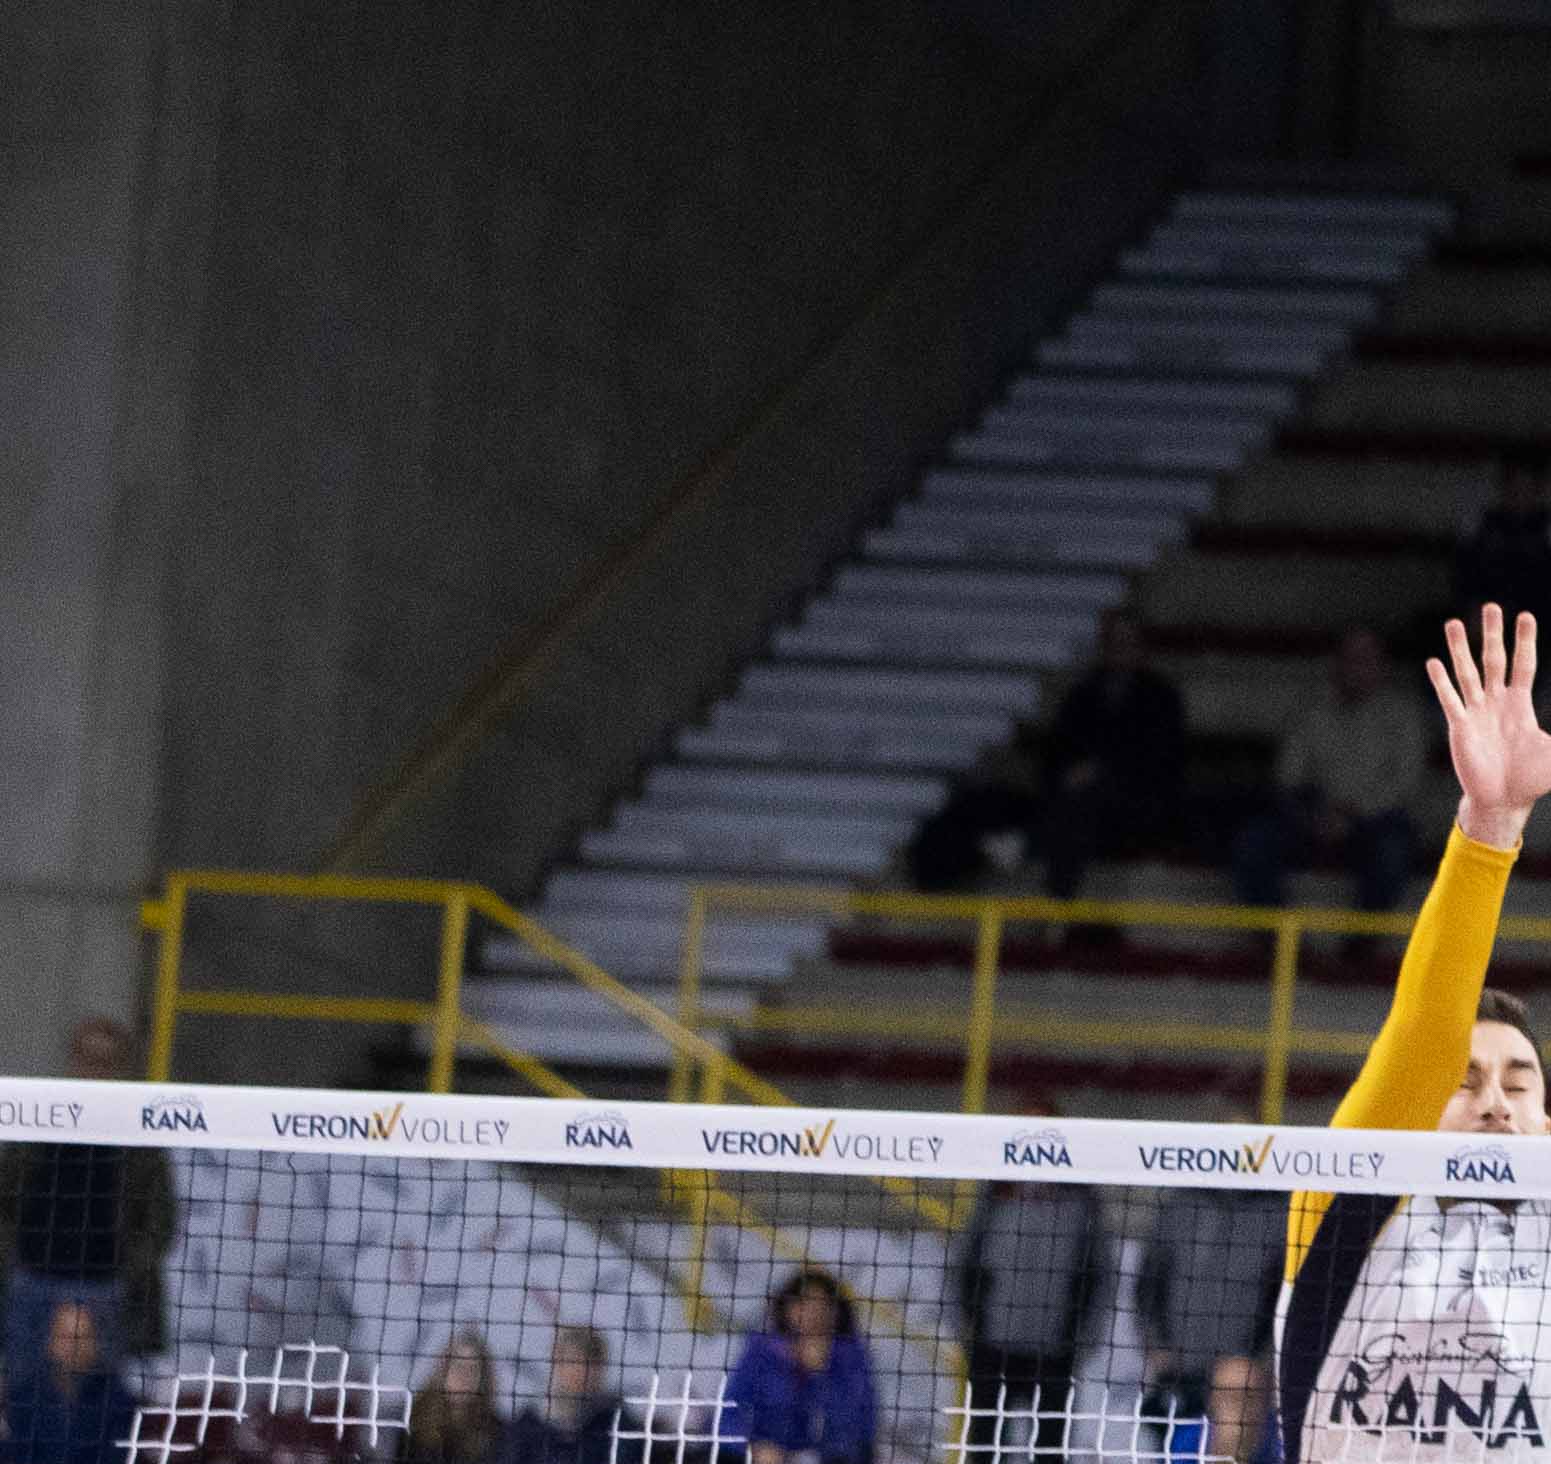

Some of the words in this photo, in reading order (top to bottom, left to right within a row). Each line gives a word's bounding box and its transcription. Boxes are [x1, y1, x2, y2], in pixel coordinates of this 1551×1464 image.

[141, 1104, 209, 1133] RANA
[565, 1122, 634, 1150] RANA
[1003, 1140, 1073, 1169] RANA
[1445, 1155, 1516, 1184] RANA
[1330, 1360, 1545, 1450] RANA
